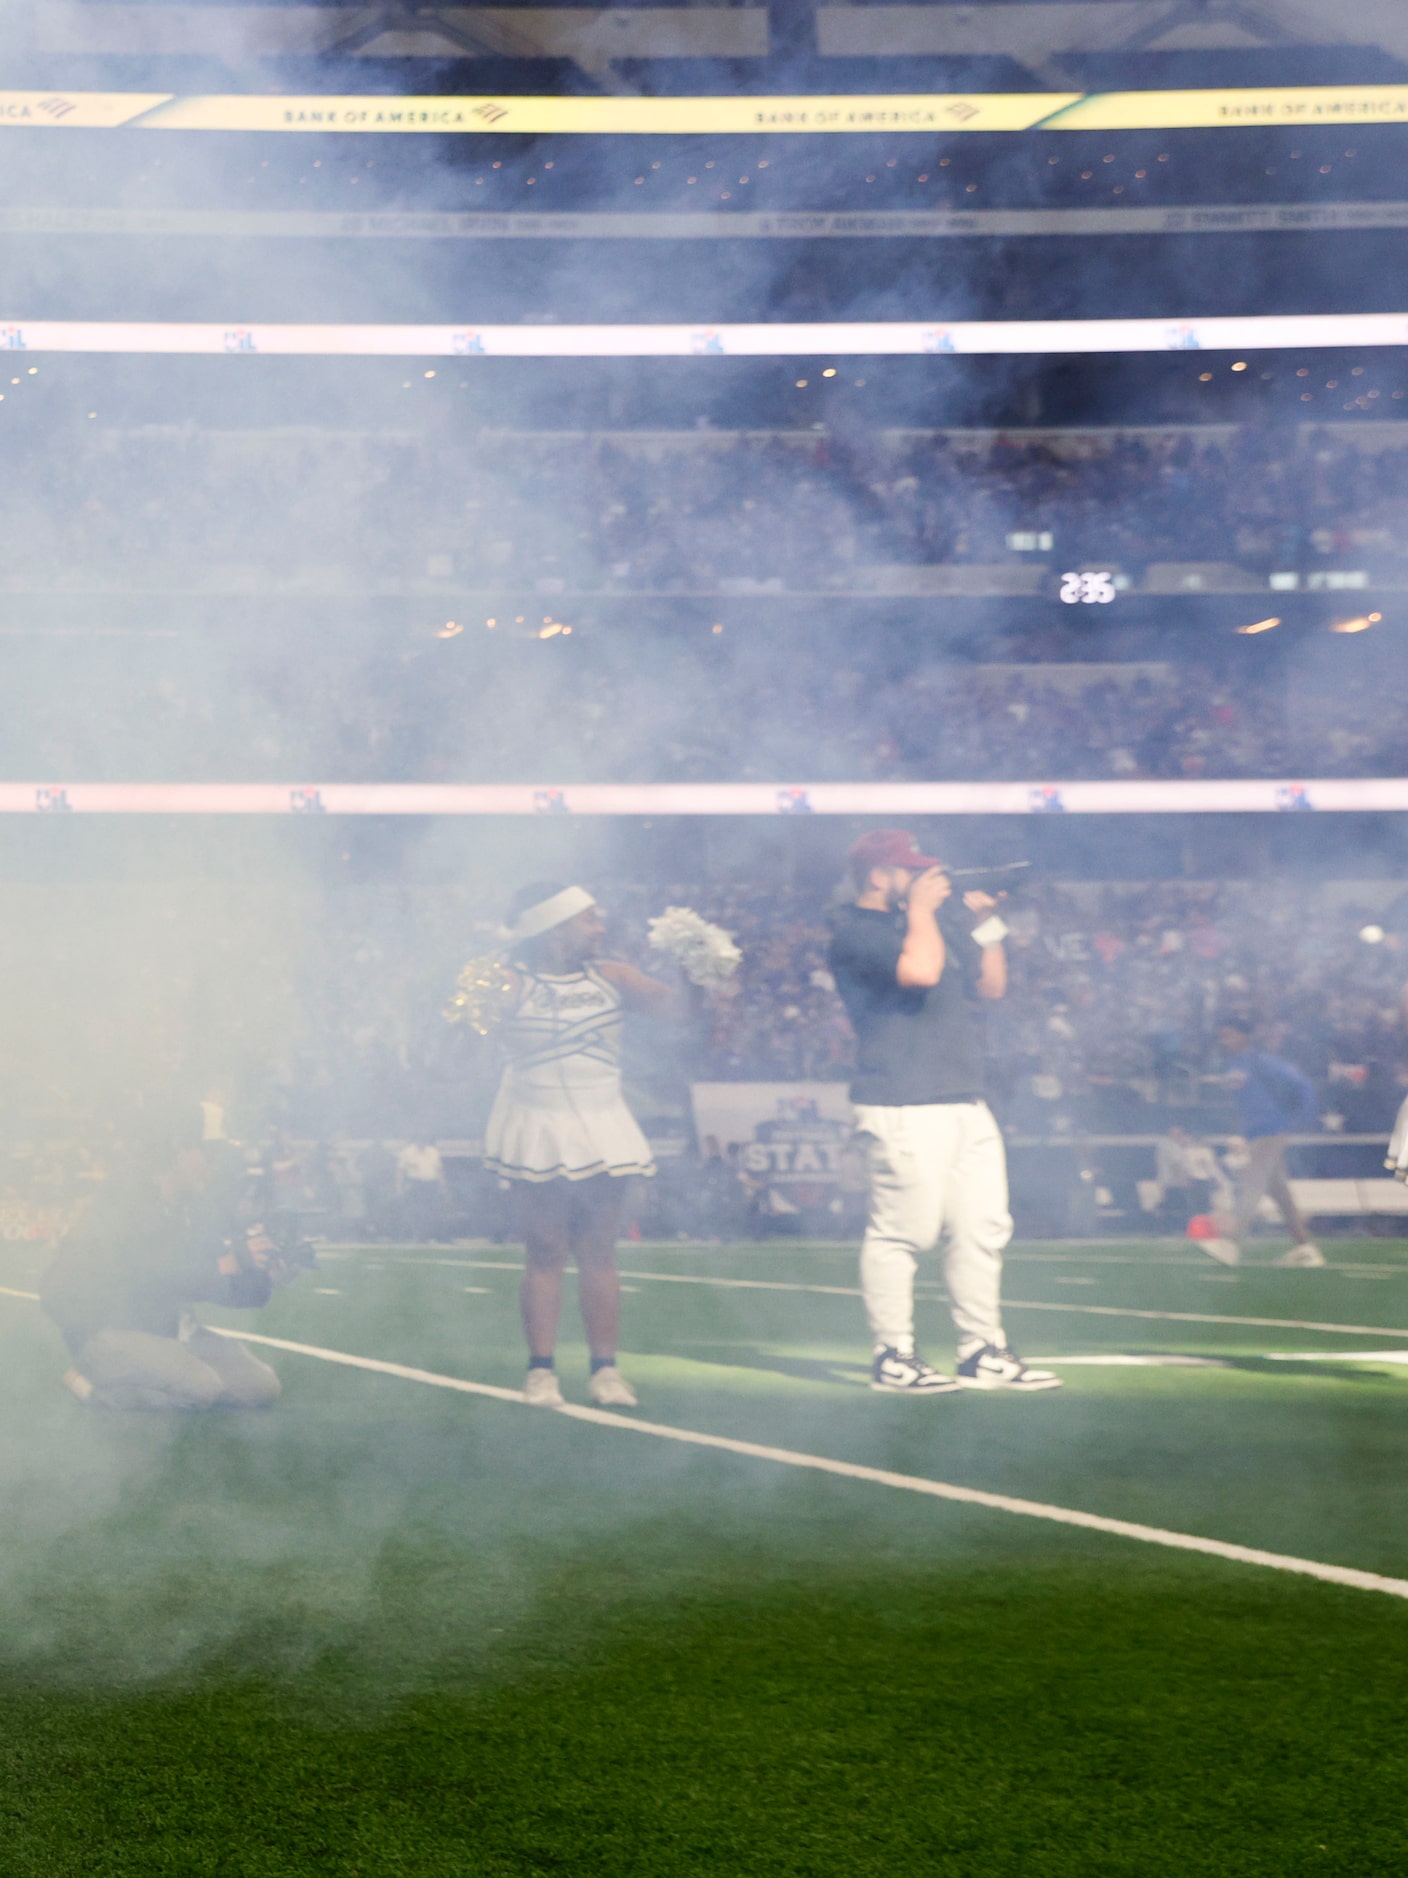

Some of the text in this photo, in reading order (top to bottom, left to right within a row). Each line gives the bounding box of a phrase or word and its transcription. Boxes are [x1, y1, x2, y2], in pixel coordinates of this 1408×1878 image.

[284, 111, 465, 123] BANK OF AMERICA
